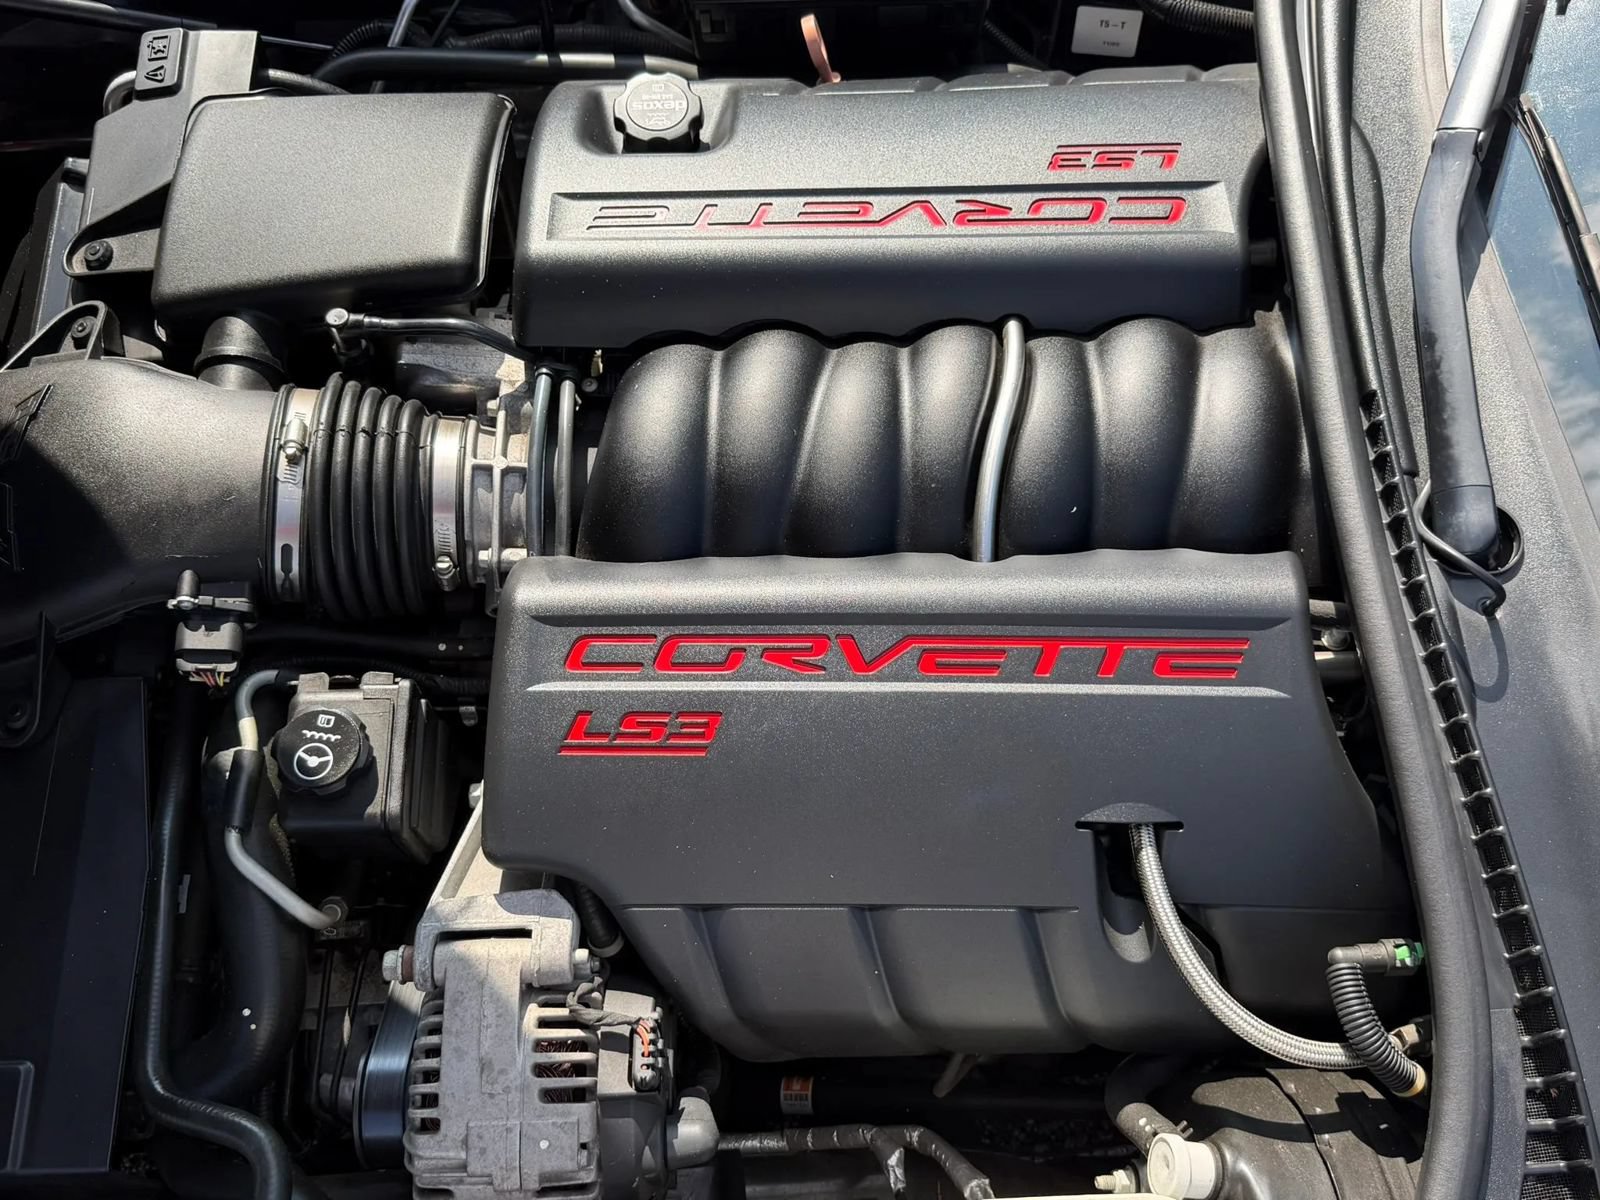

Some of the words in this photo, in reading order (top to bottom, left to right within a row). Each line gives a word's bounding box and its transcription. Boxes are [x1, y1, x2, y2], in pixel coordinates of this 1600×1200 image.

[631, 100, 686, 111] dexos
[1047, 147, 1181, 172] LS3
[586, 196, 1187, 230] CORVETTE
[564, 634, 1250, 679] CORVETTE
[559, 710, 724, 746] LS3
